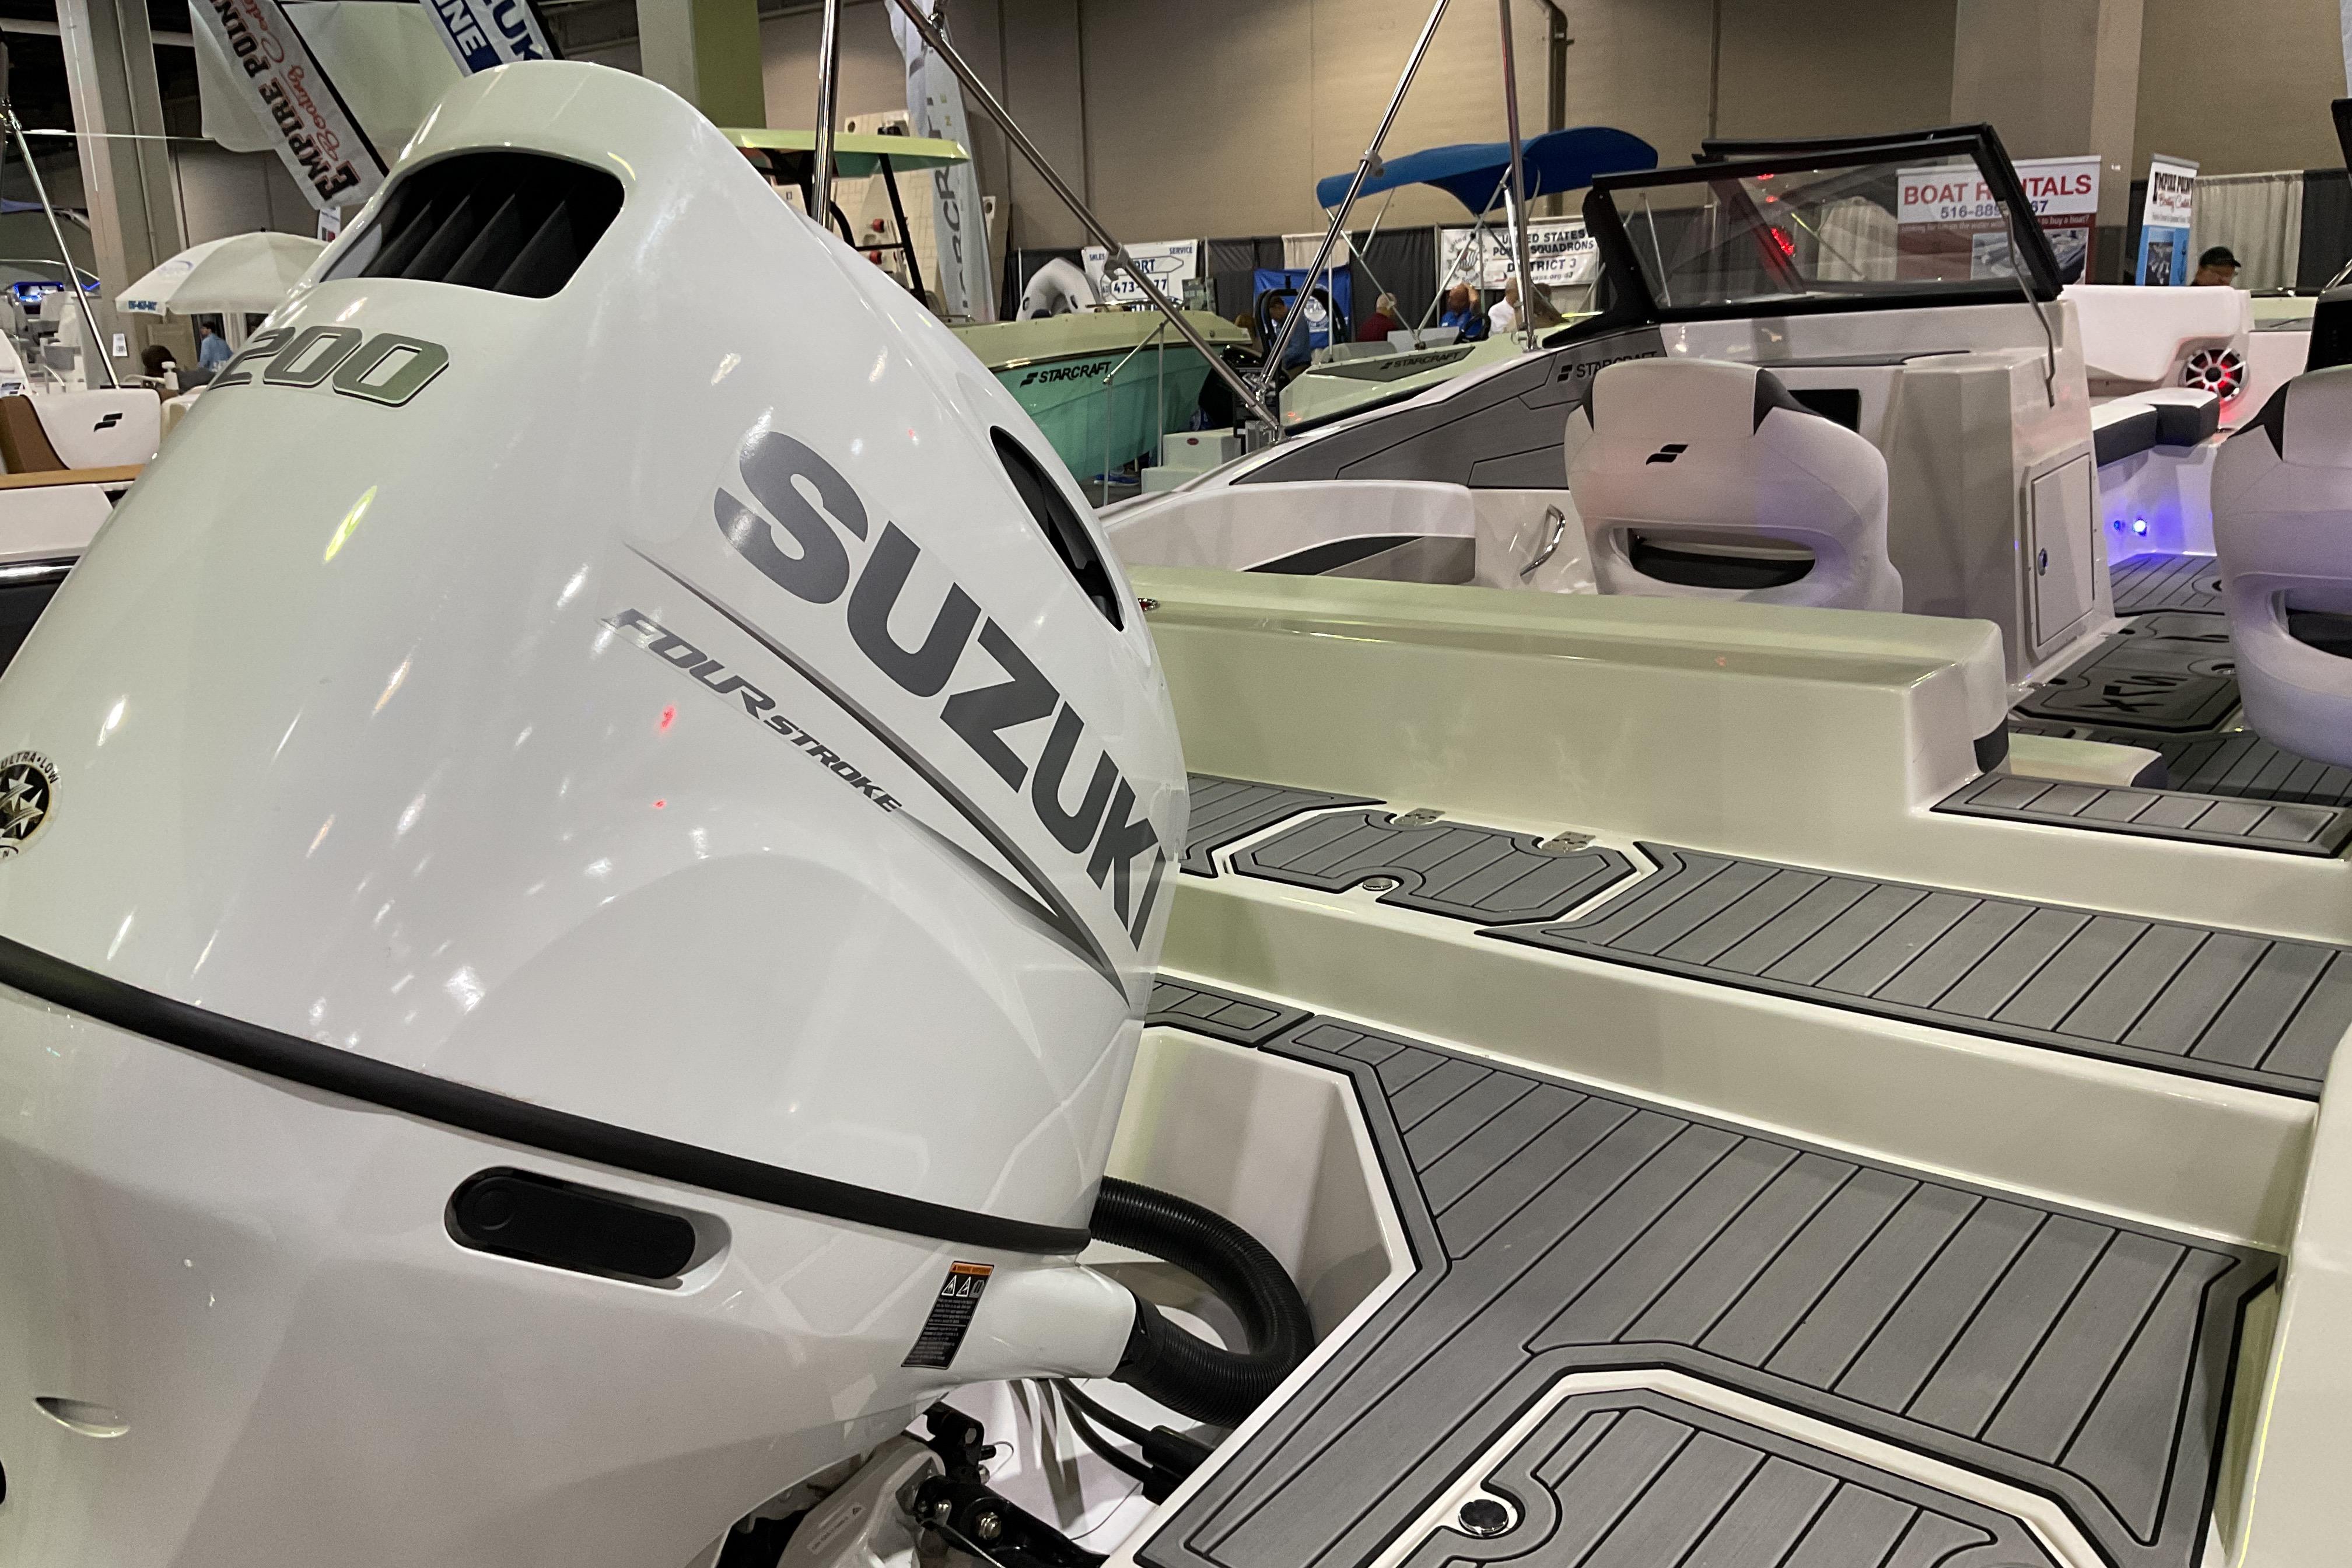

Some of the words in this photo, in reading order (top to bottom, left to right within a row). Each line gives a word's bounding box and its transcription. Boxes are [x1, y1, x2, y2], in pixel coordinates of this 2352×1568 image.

[212, 0, 271, 79] POIN
[482, 0, 543, 60] UK
[258, 77, 361, 201] EMPIRE
[1903, 183, 1969, 205] BOAT
[1975, 174, 2092, 201] RTALS
[1170, 246, 1193, 255] SERVICE
[1502, 233, 1539, 244] UED
[1544, 228, 1586, 242] STATES
[1530, 241, 1594, 254] SQUADRONS
[1507, 259, 1566, 272] DTRICT
[1570, 258, 1576, 268] 3
[206, 326, 450, 408] 200
[1038, 362, 1112, 383] STARCRAFT
[1394, 352, 1461, 368] STARCRAFT
[714, 431, 1167, 952] SUZUKI
[601, 608, 776, 720] FOUR
[763, 715, 902, 813] STROKE
